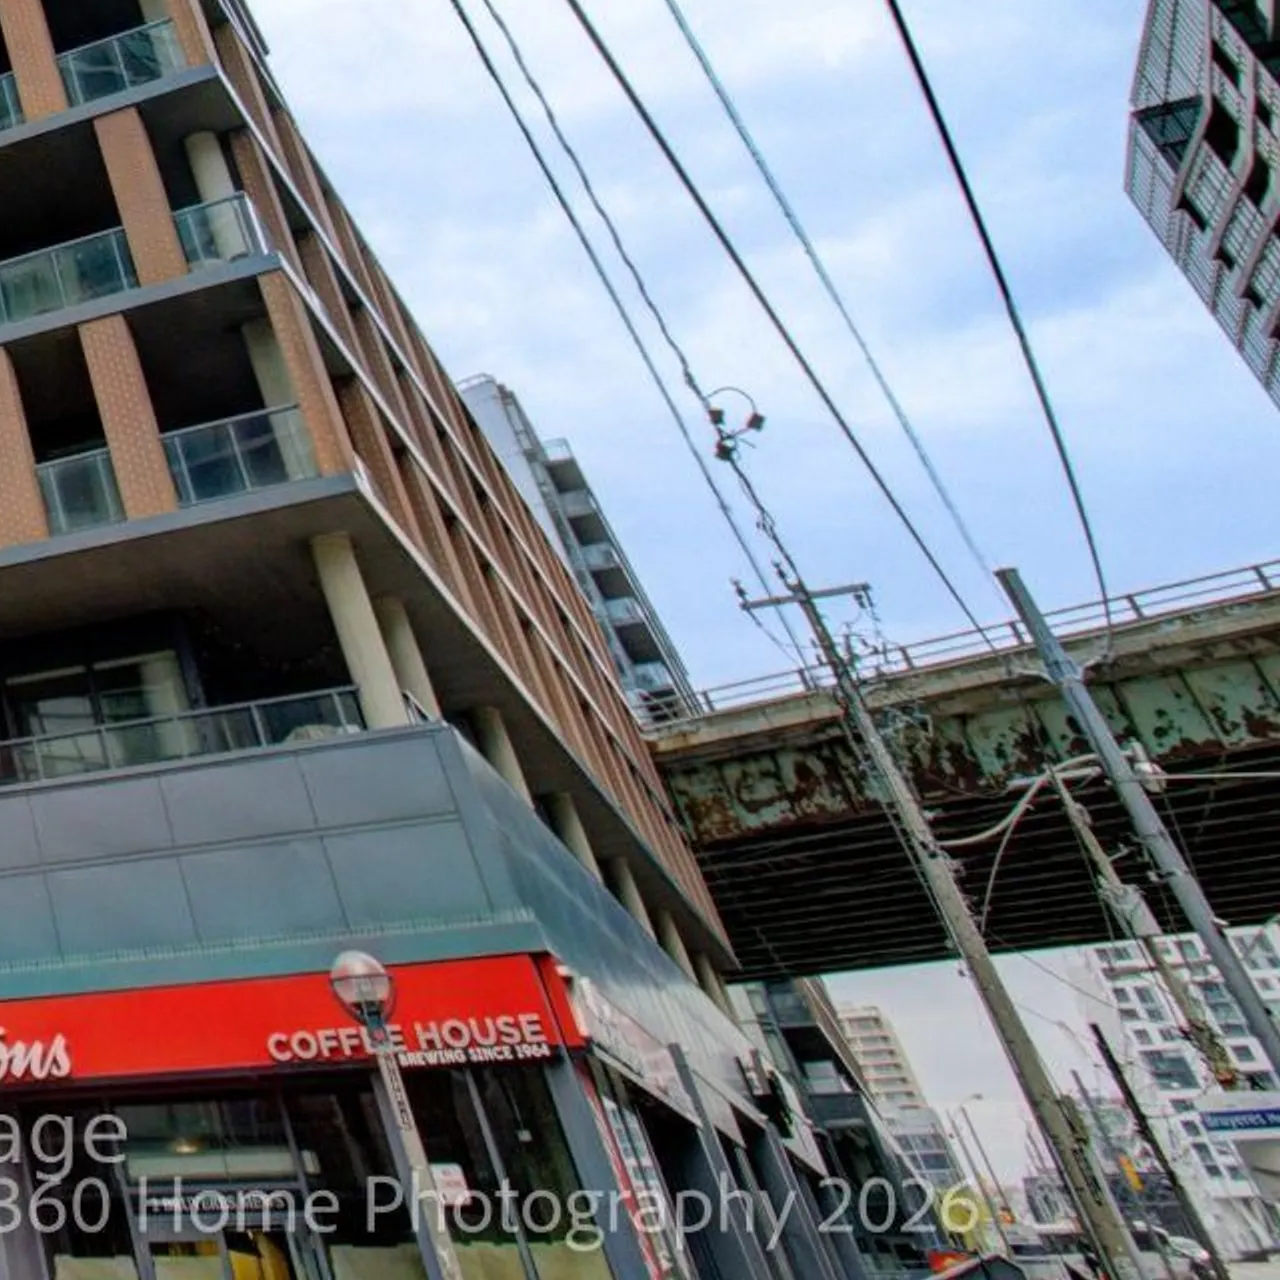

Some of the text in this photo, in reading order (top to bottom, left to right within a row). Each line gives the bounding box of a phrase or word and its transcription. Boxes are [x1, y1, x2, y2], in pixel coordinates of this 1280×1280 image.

[415, 1013, 546, 1050] HOUSE
[398, 1042, 552, 1067] BREWING SINCE 1964
